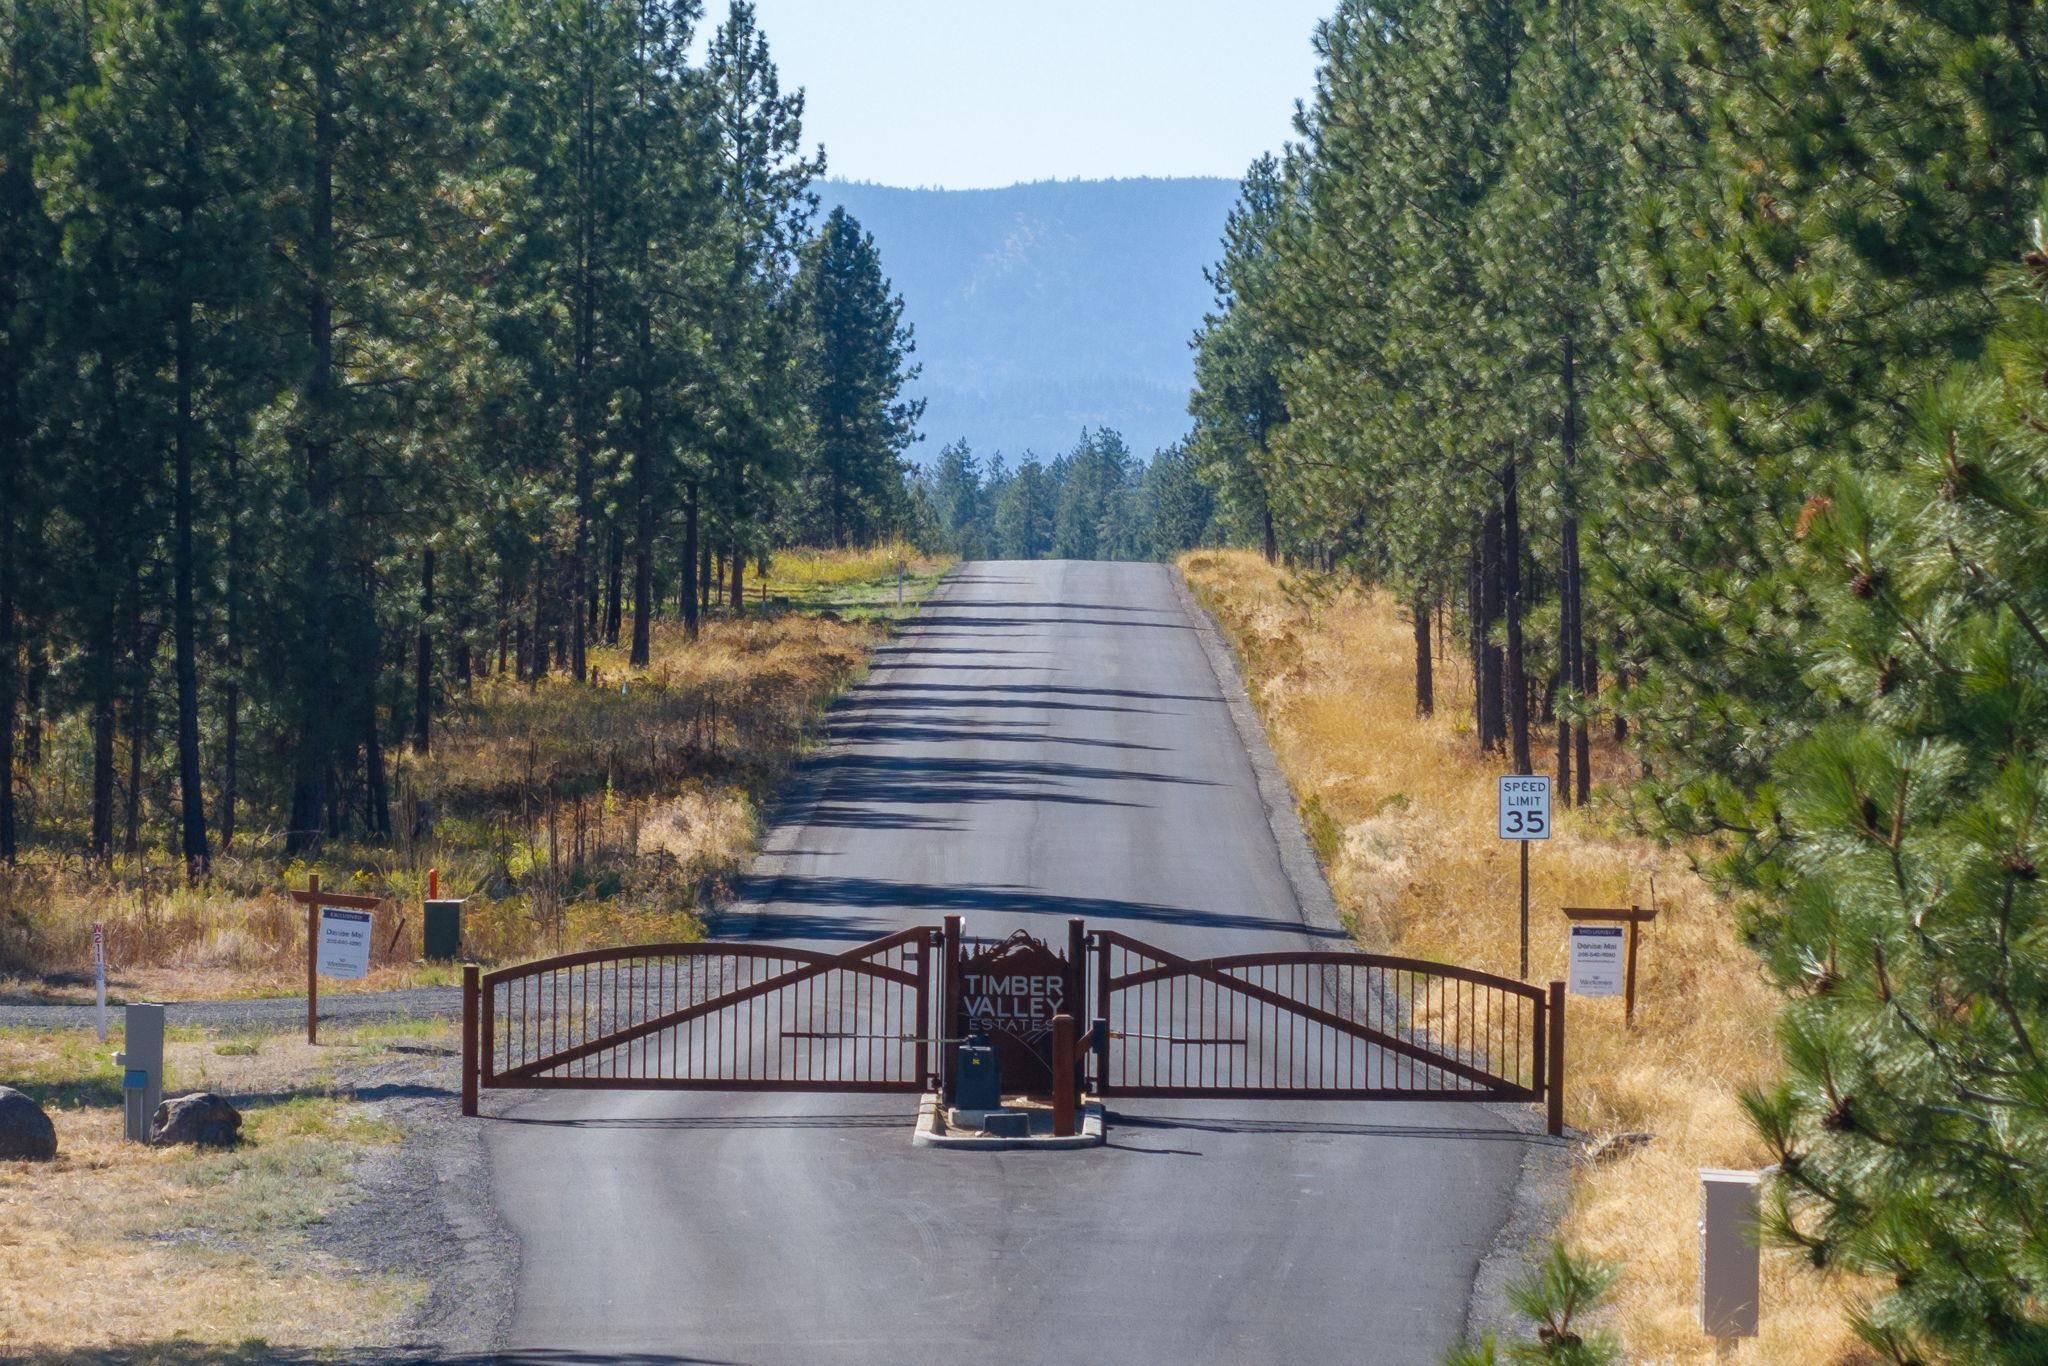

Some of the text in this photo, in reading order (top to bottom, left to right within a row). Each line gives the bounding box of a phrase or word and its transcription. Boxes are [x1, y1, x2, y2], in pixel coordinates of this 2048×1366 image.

[1503, 782, 1546, 792] SPEED
[1508, 796, 1541, 806] LIMIT
[1506, 810, 1545, 833] 35
[964, 975, 1064, 996] TIMBER
[963, 995, 1064, 1018] VALLEY
[969, 1019, 1054, 1032] ESTATES
